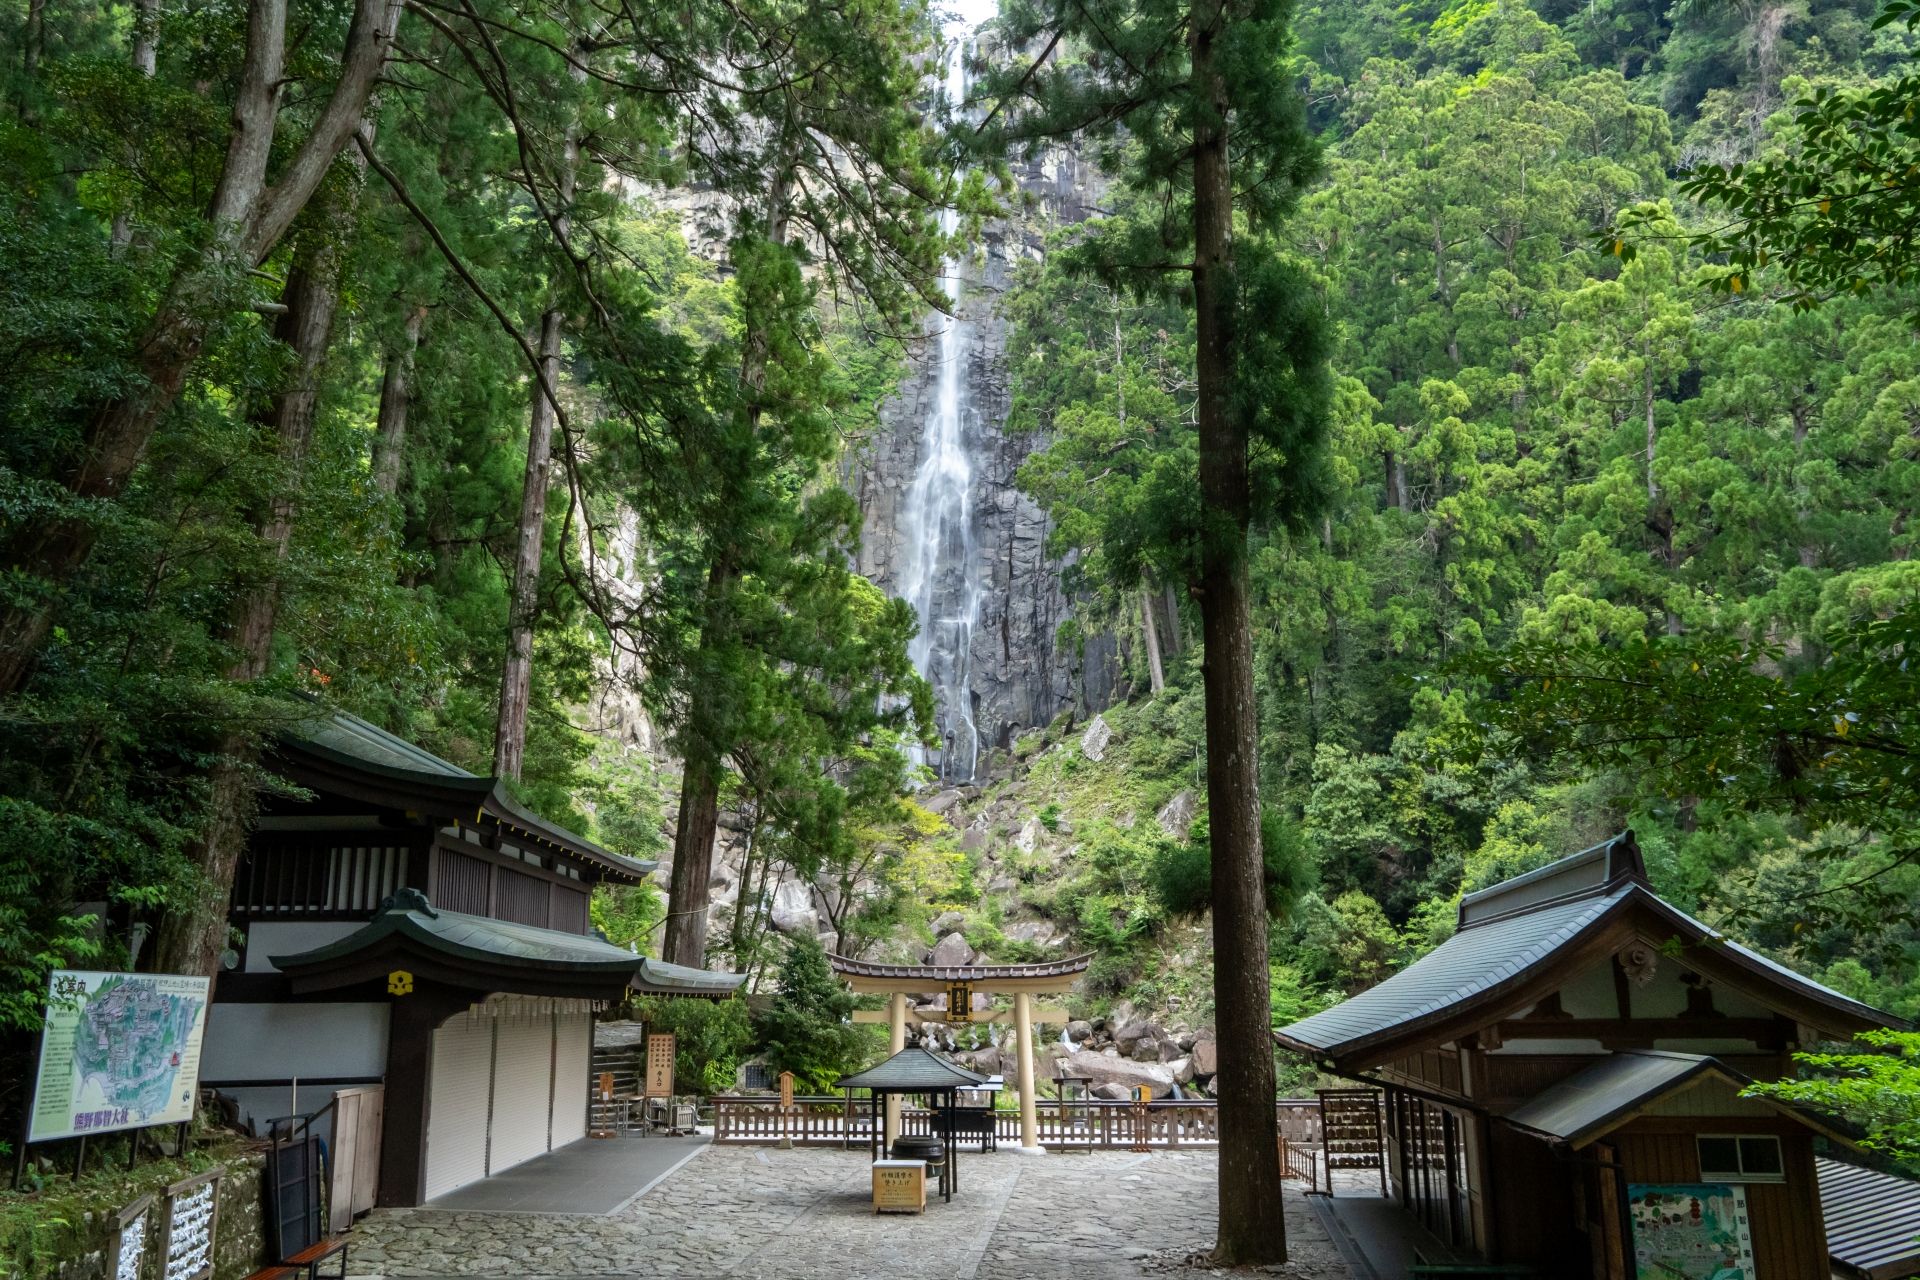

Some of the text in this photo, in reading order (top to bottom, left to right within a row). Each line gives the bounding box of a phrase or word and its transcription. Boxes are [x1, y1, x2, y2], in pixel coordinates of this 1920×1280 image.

[54, 976, 86, 997] 案内
[74, 1107, 129, 1132] 熊野那智大社
